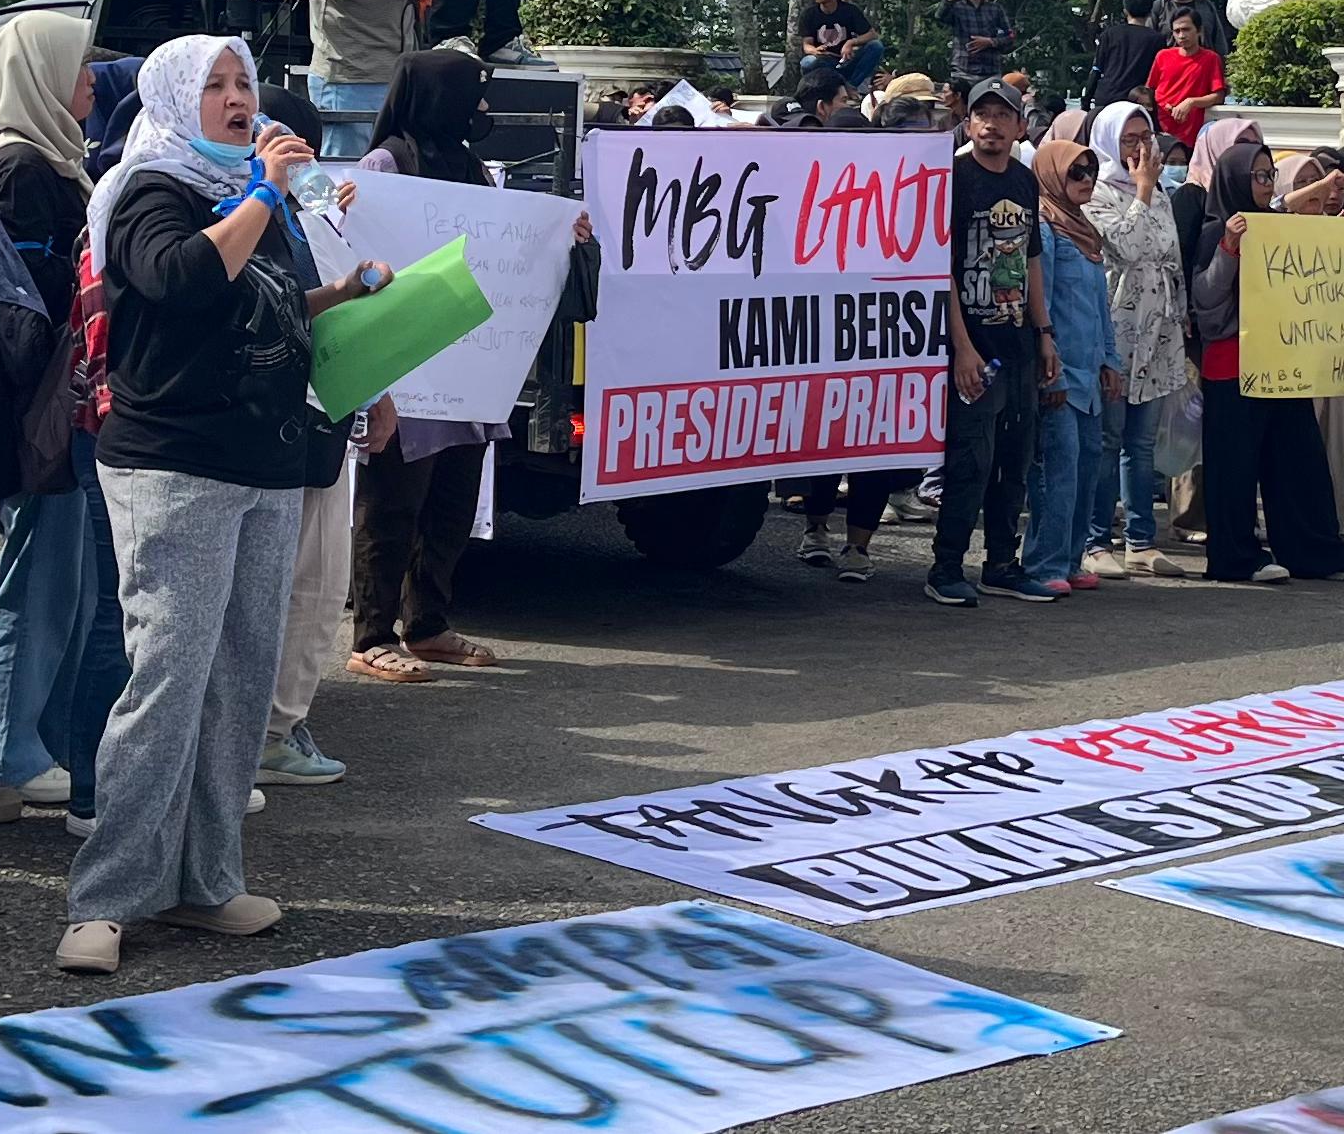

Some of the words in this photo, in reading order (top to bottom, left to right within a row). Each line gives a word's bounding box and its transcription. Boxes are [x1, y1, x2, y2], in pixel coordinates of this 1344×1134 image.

[622, 147, 780, 279] MBG
[1263, 242, 1344, 288] KALAU
[718, 294, 821, 370] KAMI
[834, 290, 951, 363] BERSA
[1278, 317, 1338, 346] UNTUK
[604, 379, 810, 473] PRESIDEN
[536, 749, 1064, 852] TANGKAP
[774, 811, 1156, 910] BUKAN
[212, 904, 827, 1034] SAMPAI
